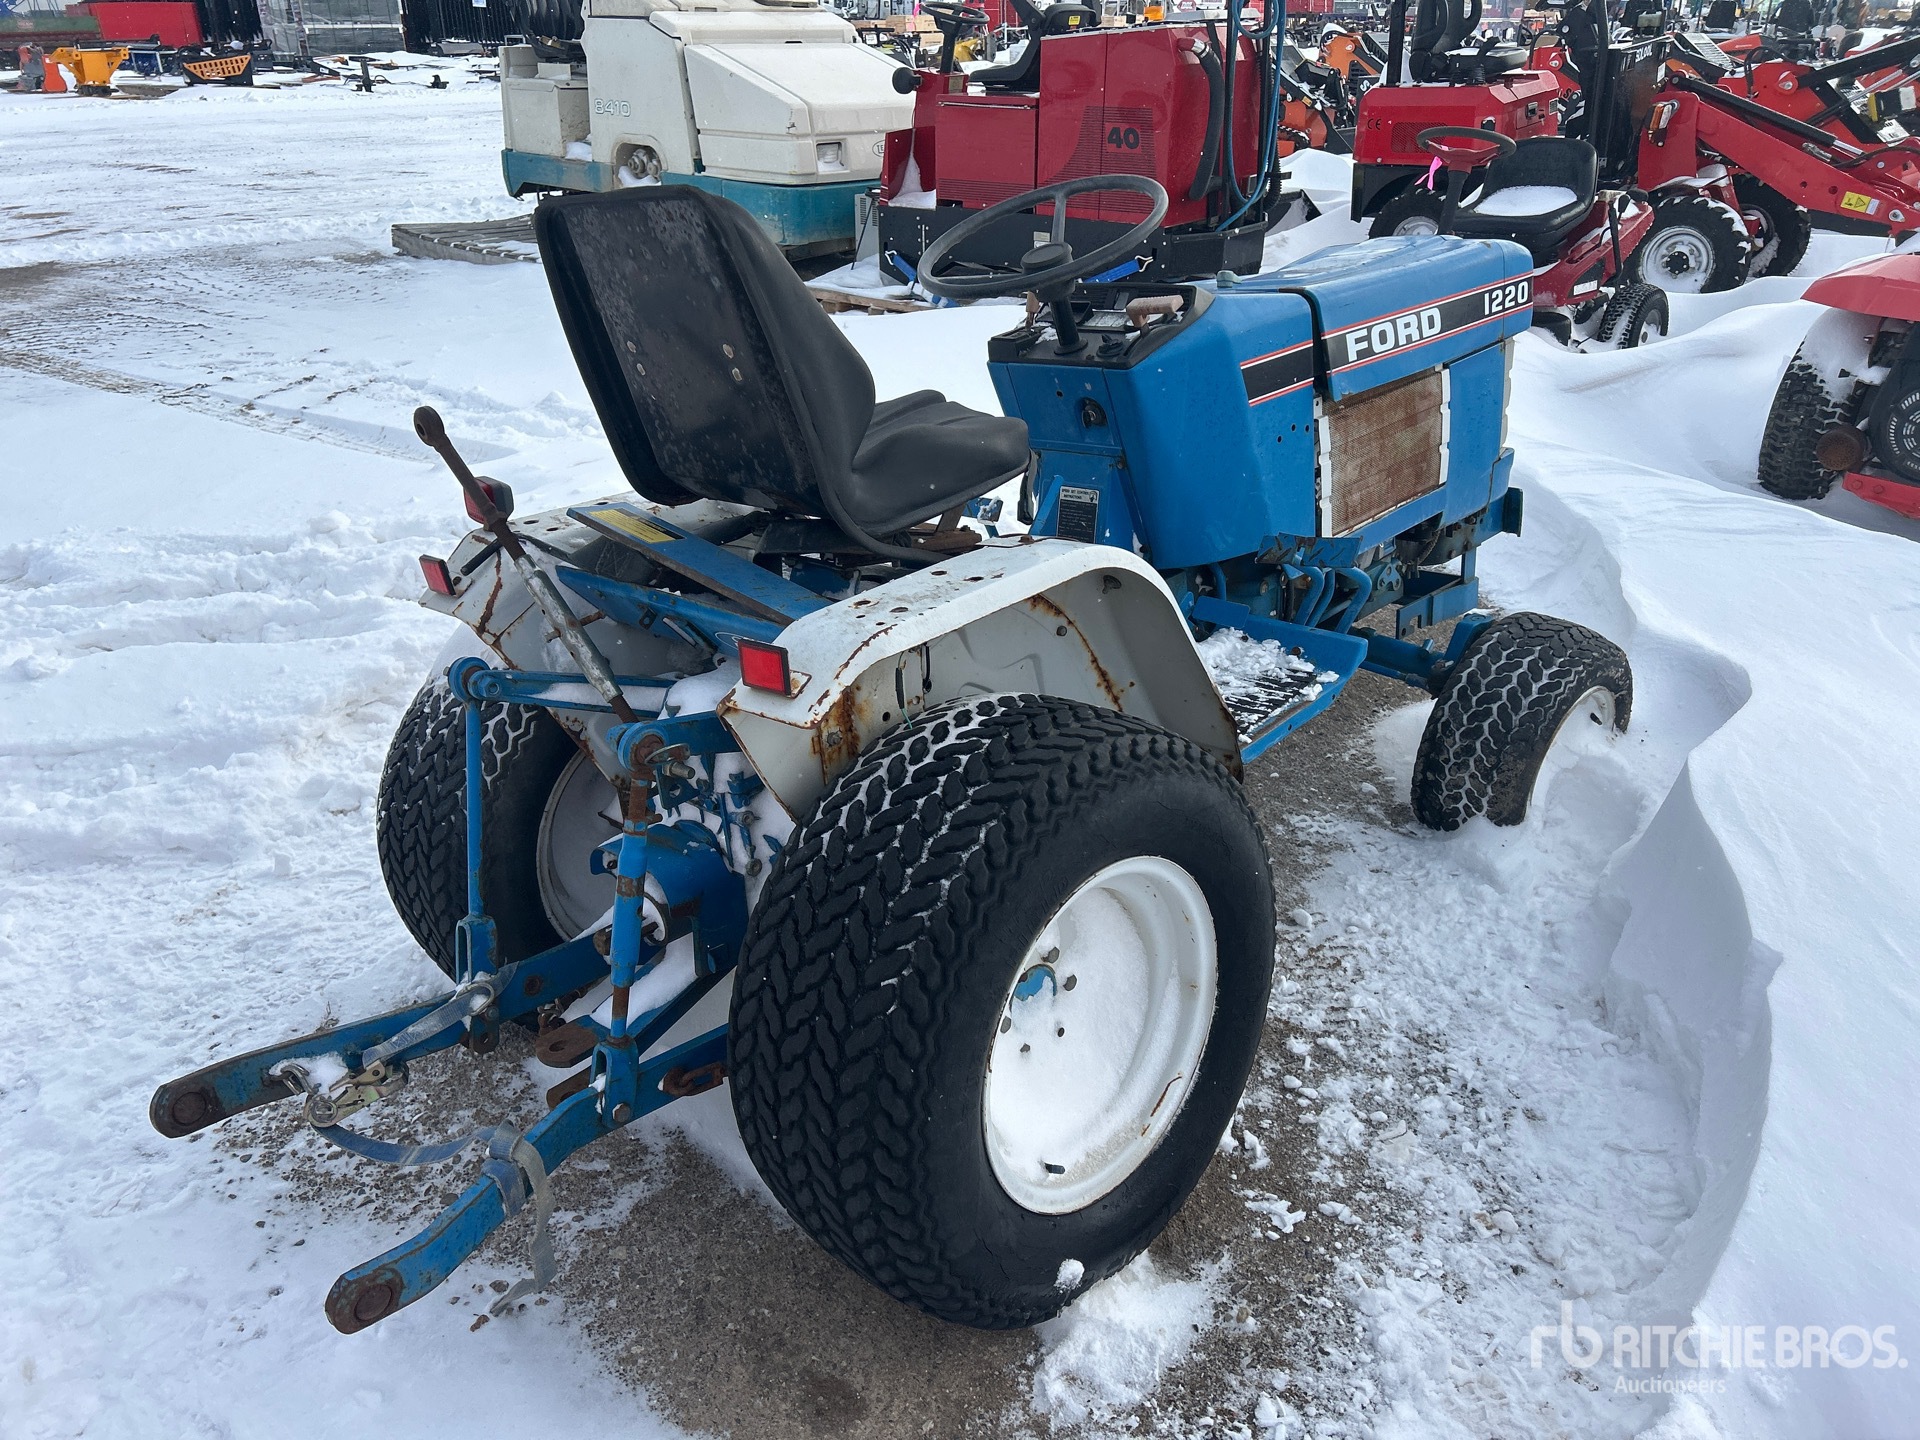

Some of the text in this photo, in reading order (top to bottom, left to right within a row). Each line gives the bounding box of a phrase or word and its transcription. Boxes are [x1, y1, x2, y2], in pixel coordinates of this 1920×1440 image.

[595, 98, 631, 117] 8410
[1107, 126, 1140, 149] 40
[1346, 280, 1529, 362] FORD 1220
